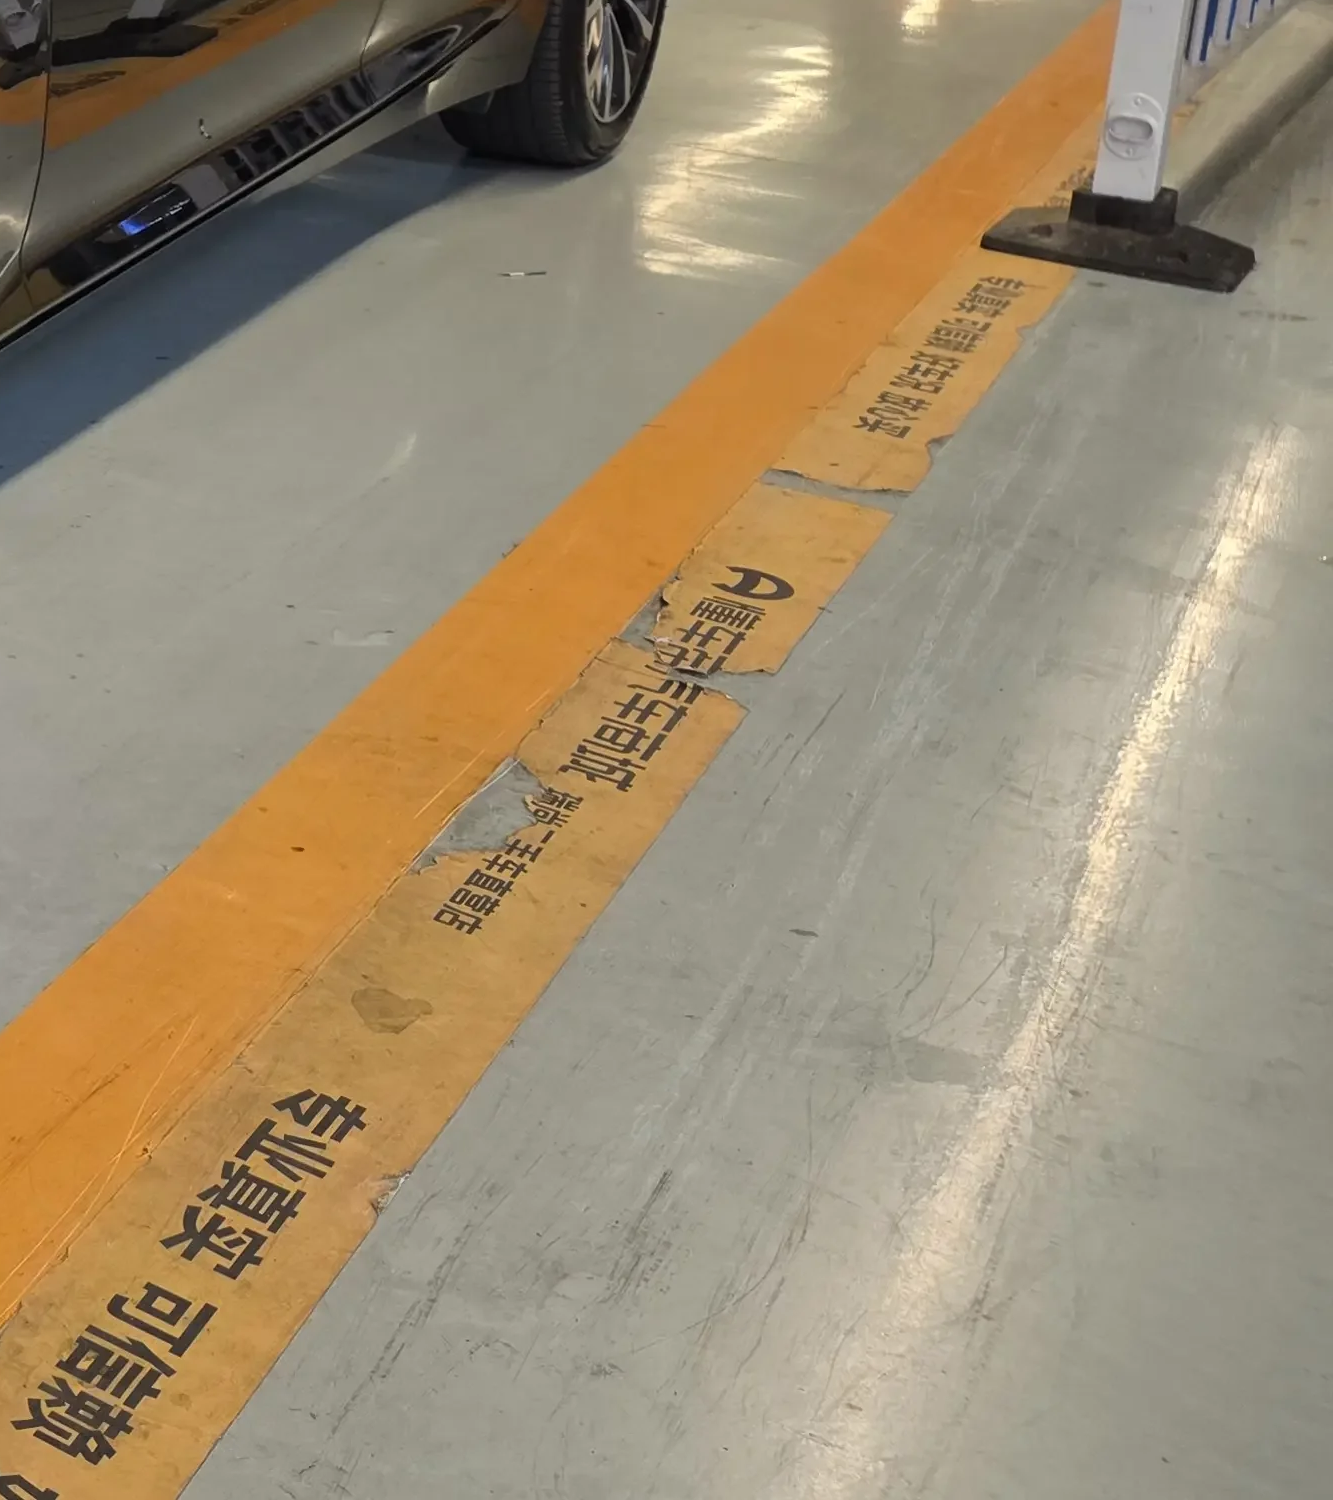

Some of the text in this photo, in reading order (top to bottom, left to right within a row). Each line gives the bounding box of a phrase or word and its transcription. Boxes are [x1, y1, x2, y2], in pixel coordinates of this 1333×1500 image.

[952, 276, 1025, 318] 专业真实
[890, 350, 964, 394] 好车况
[852, 391, 932, 438] 放心买
[10, 1088, 367, 1466] 专业真实 可信赖
